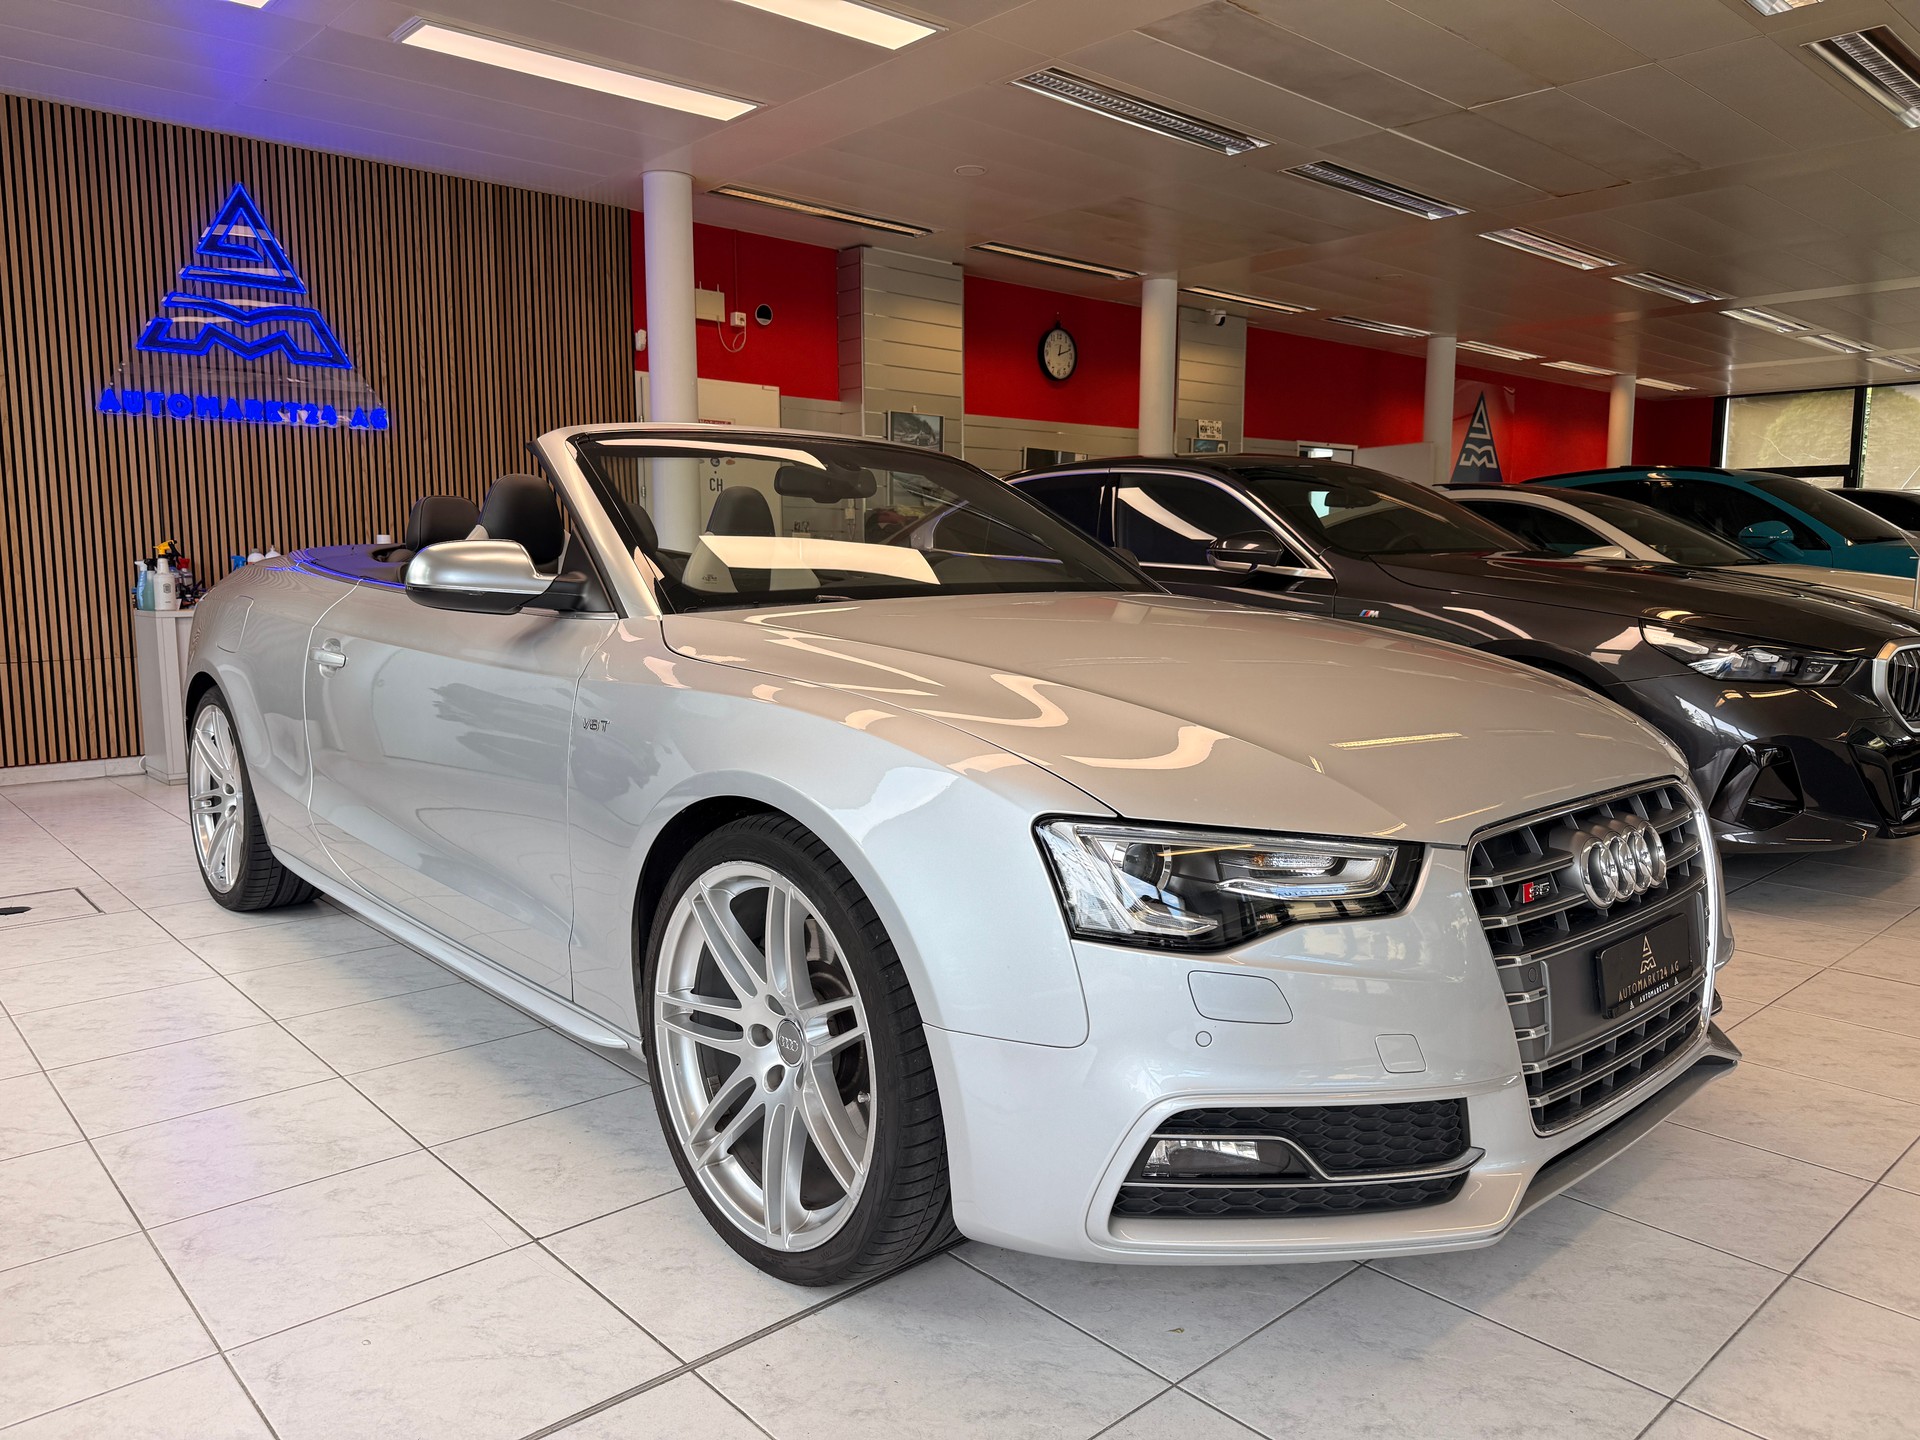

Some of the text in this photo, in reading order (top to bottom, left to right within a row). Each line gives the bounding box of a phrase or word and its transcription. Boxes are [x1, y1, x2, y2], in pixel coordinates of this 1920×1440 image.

[98, 388, 389, 430] AUTOMARKT24 AG
[709, 478, 723, 492] CH
[1528, 882, 1550, 898] S5
[1618, 960, 1679, 1002] AUTOMARKT24 AG
[1639, 982, 1670, 1003] AUTOMARKT24
